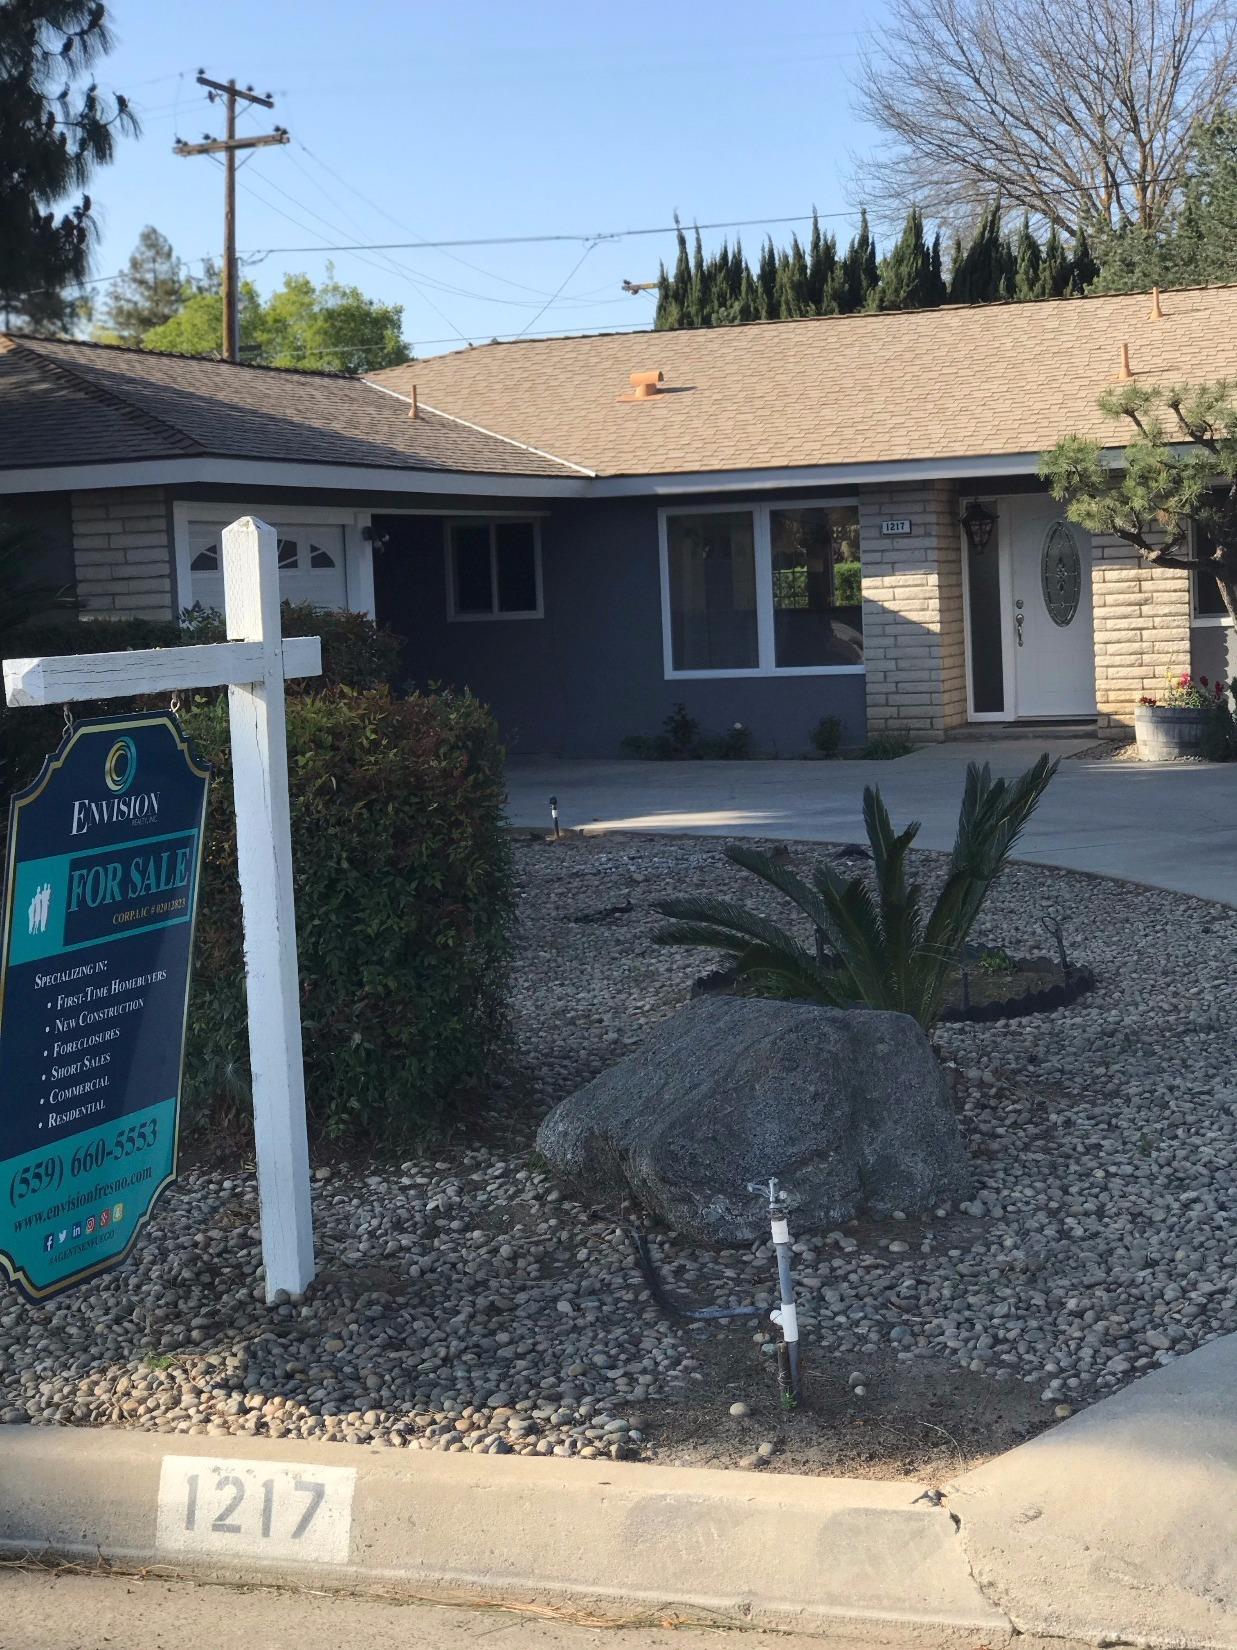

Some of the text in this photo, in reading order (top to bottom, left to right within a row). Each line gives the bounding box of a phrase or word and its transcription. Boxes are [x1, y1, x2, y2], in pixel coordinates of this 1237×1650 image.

[885, 521, 905, 531] 1217
[69, 792, 160, 836] ENVISION
[68, 847, 190, 912] FOR SALE
[34, 960, 108, 989] SPECIALIZING IN:
[57, 970, 167, 1010] FIRST-TIME HOMEBUYERS
[55, 998, 145, 1034] NEW CONSTRUCTION
[52, 1028, 120, 1058] FORECLOSURES
[51, 1052, 111, 1081] SHORT SALES
[50, 1075, 110, 1104] COMMERCIAL
[48, 1100, 106, 1128] RESIDENTIAL
[10, 1118, 157, 1208] (559) 660-5553
[14, 1165, 153, 1233] www.envisionfresno.com
[184, 1473, 326, 1540] 1217
